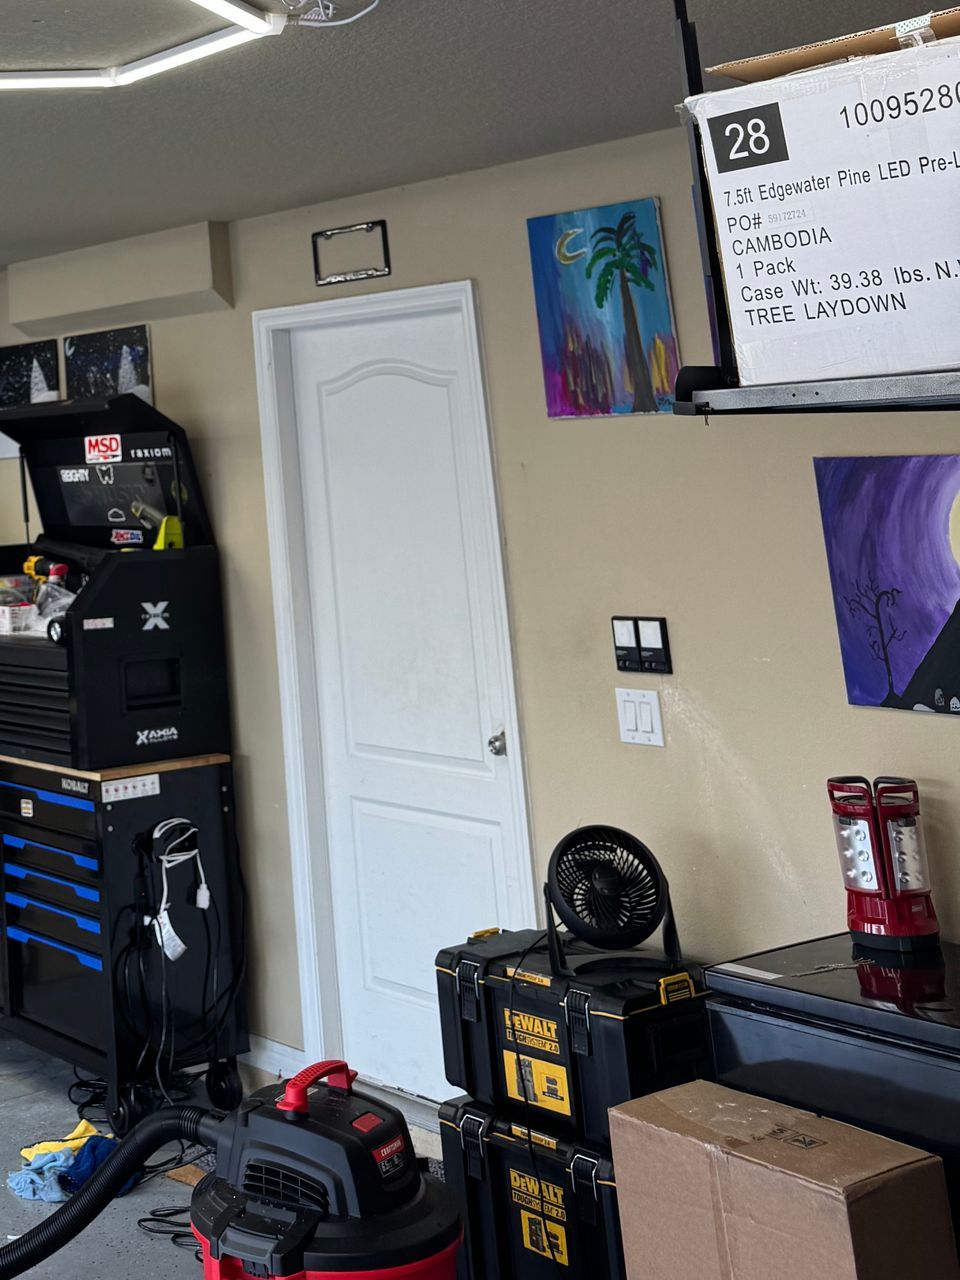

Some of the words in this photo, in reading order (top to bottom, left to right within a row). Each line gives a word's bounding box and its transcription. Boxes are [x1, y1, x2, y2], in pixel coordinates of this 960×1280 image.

[725, 118, 770, 160] 28
[723, 187, 754, 207] 7.5ft
[758, 175, 831, 202] Edgewater
[837, 169, 872, 187] Pine
[877, 159, 912, 181] LED
[727, 212, 763, 234] PO#
[767, 209, 808, 224] 59172724
[732, 226, 833, 256] CAMBODIA
[736, 263, 744, 279] 1
[753, 256, 797, 277] Pack
[741, 285, 784, 302] Case
[791, 278, 822, 297] Wt:
[829, 269, 883, 291] 39.38
[744, 304, 796, 326] TREE
[804, 292, 907, 320] LAYDOWN
[88, 437, 119, 455] MSD
[130, 447, 172, 459] raxiom
[61, 777, 89, 794] KOBALT
[510, 1170, 564, 1206] DEWALT
